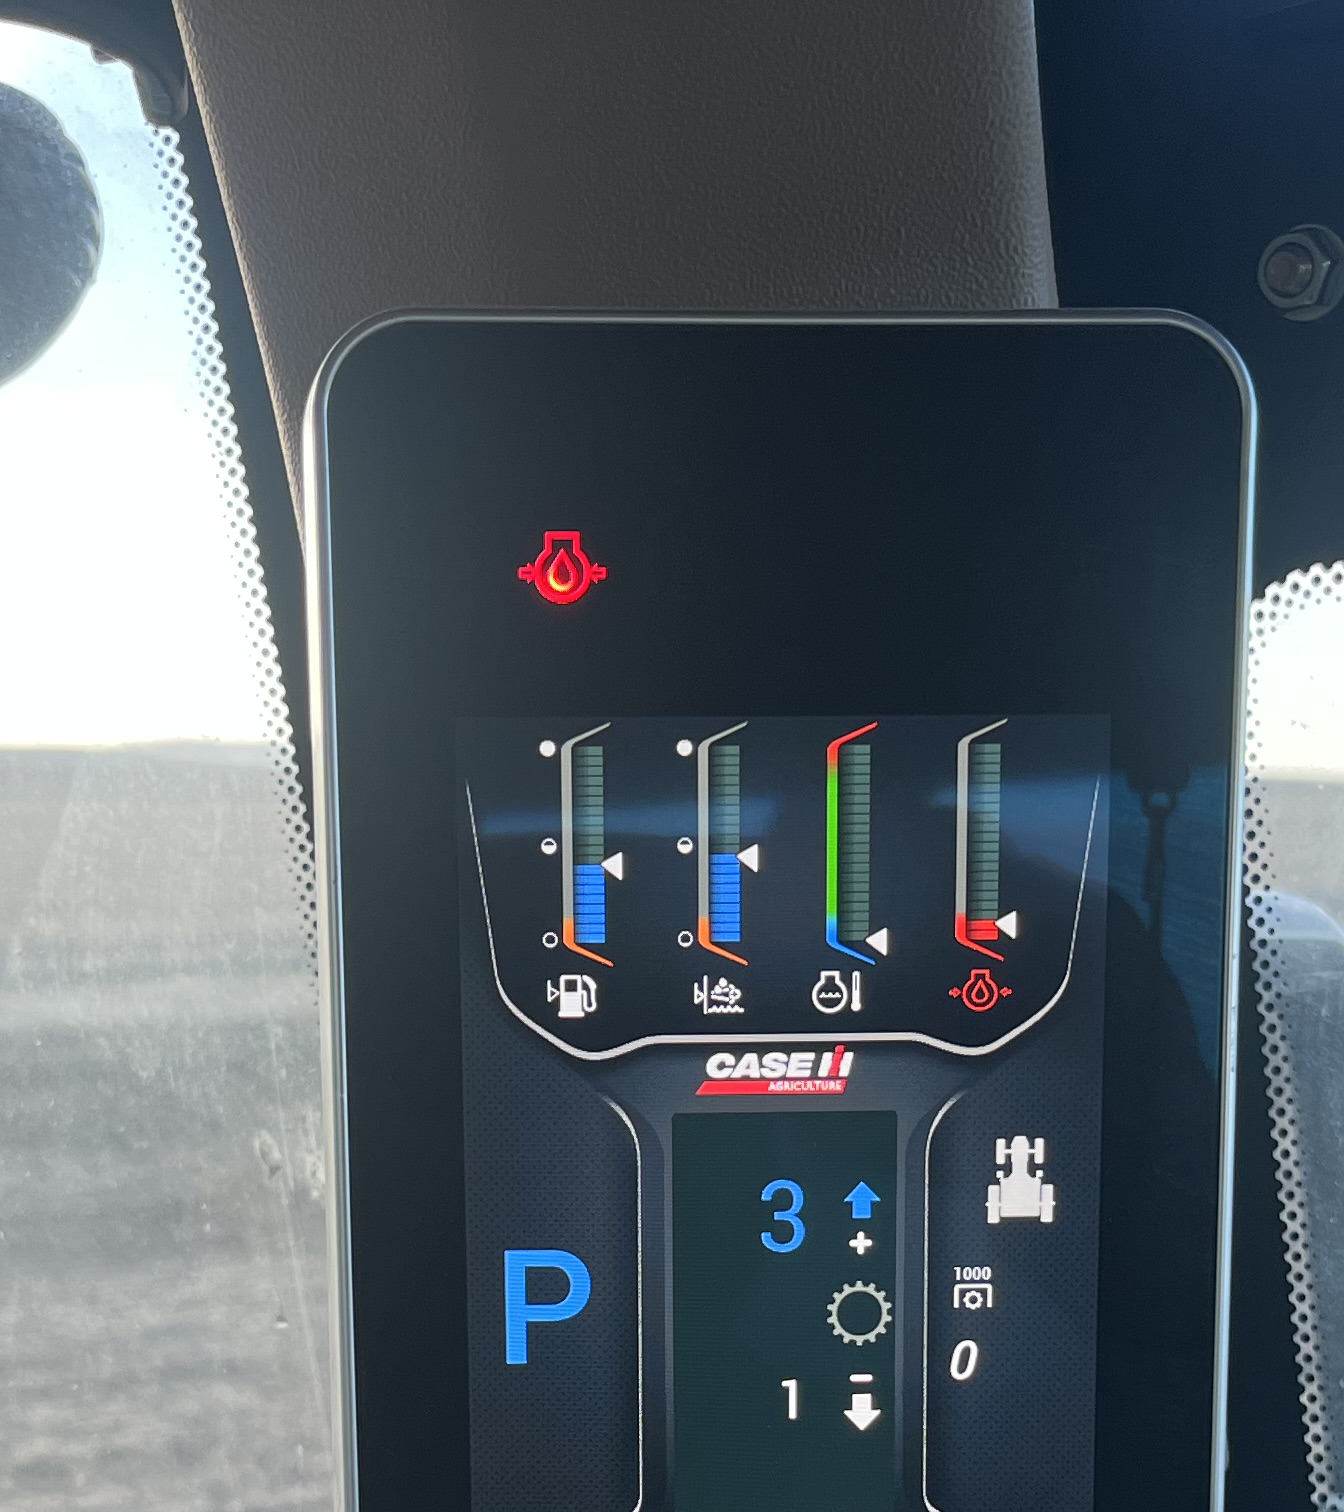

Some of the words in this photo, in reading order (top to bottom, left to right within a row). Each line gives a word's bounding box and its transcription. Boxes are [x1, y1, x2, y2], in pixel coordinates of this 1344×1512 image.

[706, 1052, 815, 1079] CASE
[767, 1080, 843, 1092] AGRICULTURE
[761, 1180, 806, 1254] 3
[954, 1266, 992, 1280] 1000
[504, 1250, 592, 1365] P
[950, 1340, 978, 1381] 0
[781, 1379, 798, 1420] 1
